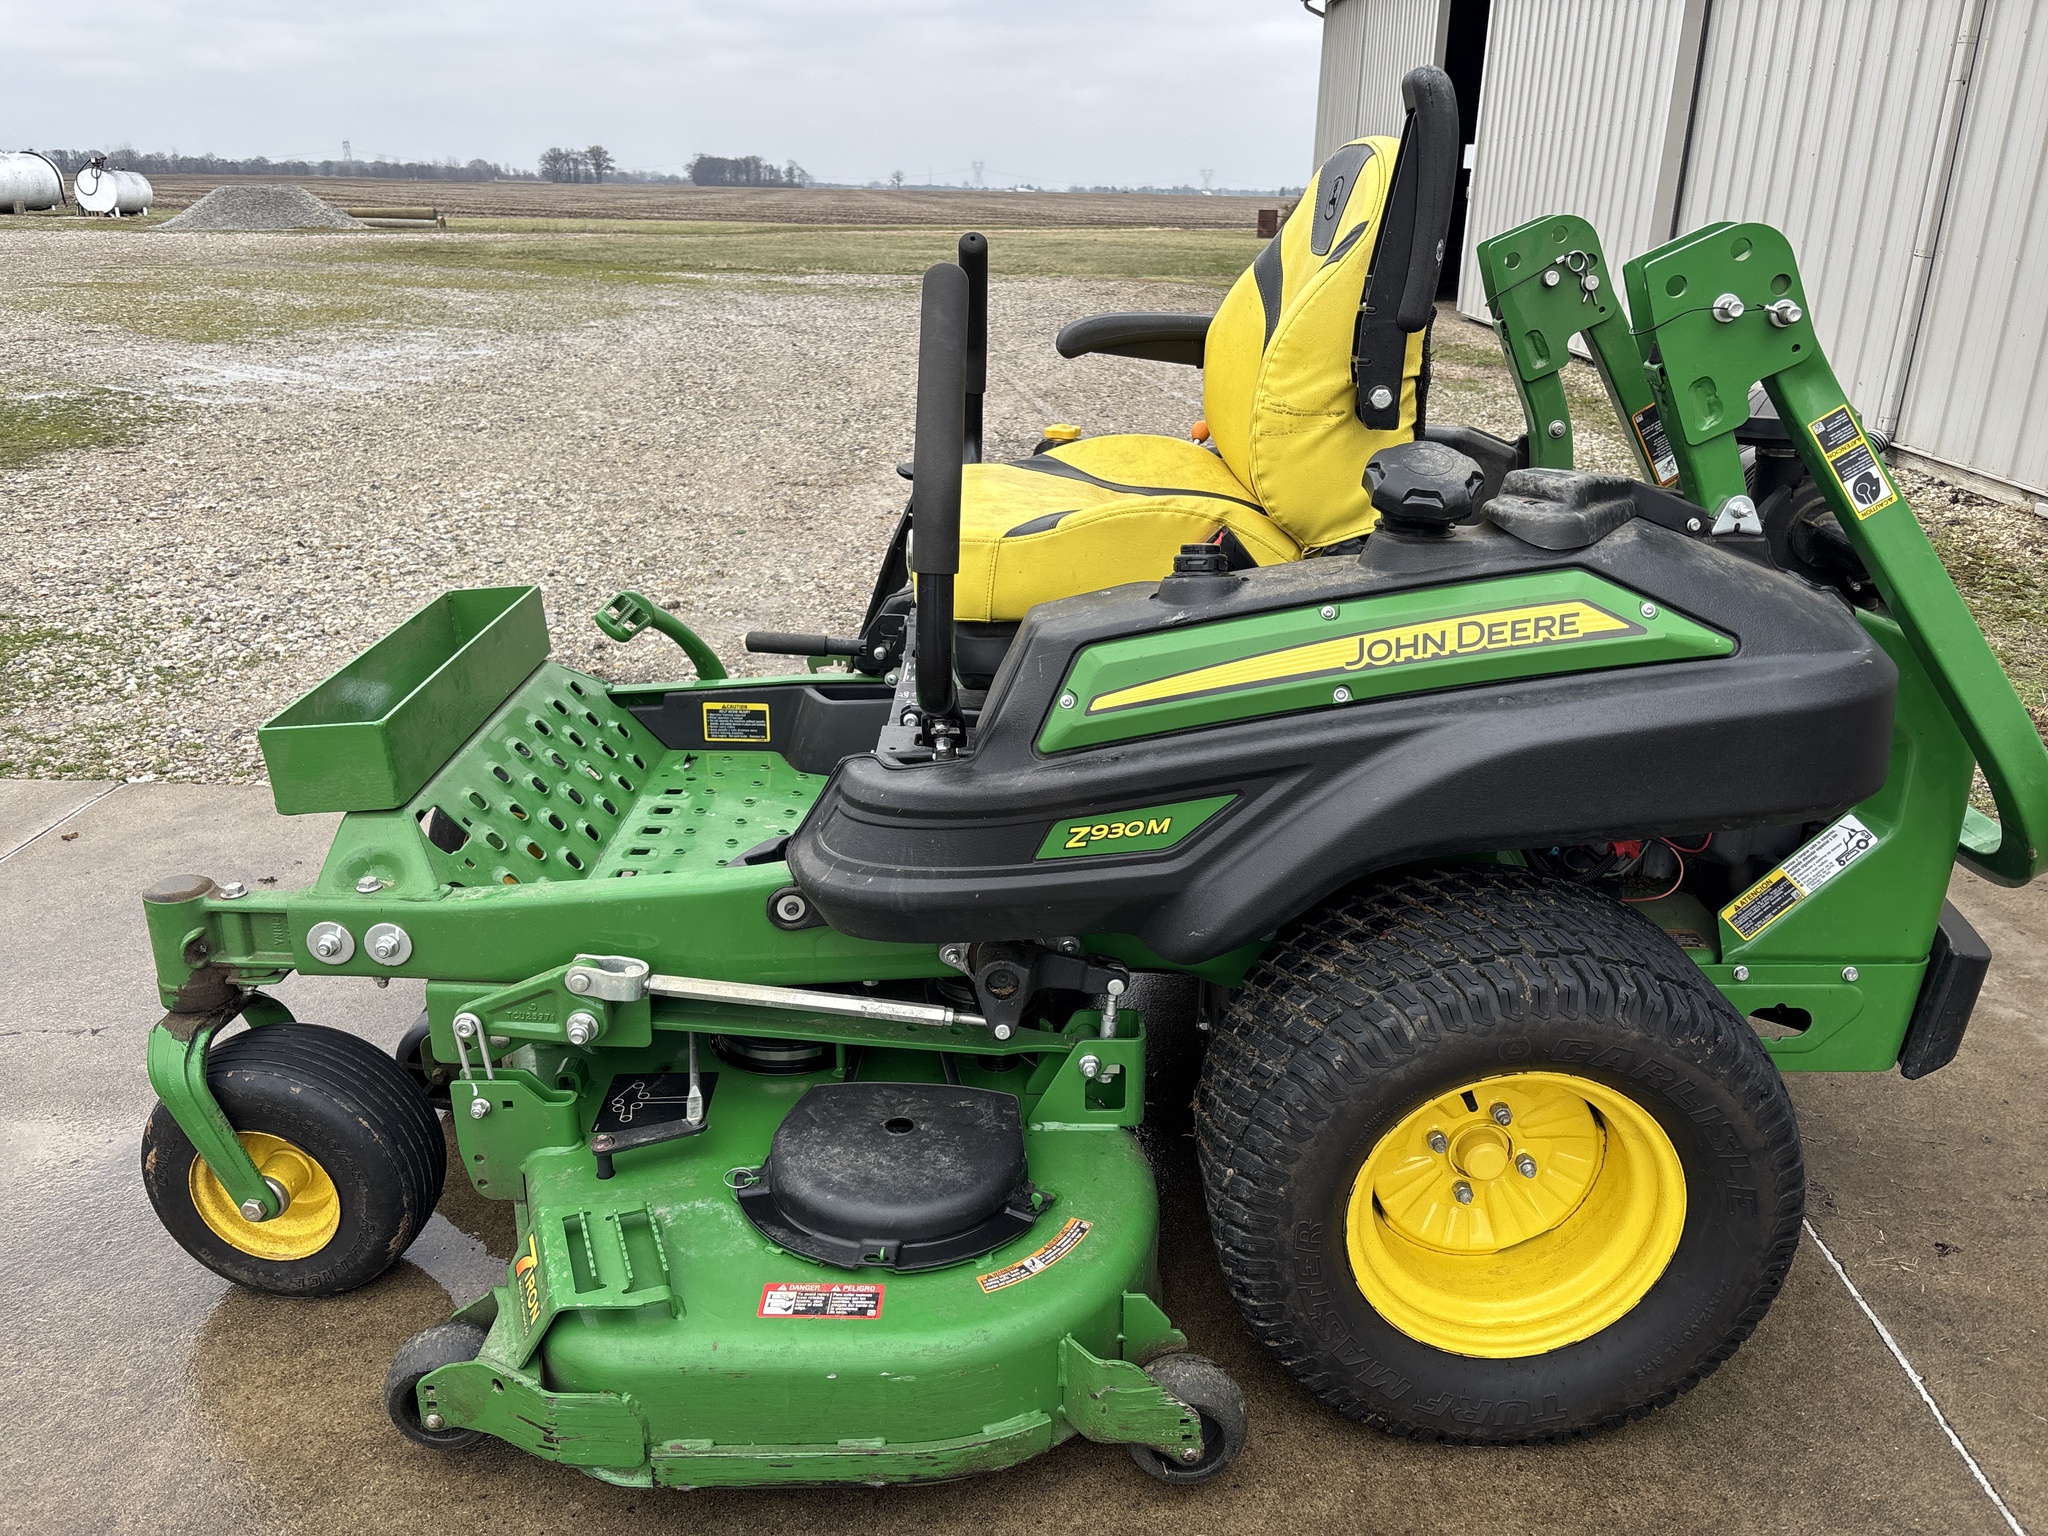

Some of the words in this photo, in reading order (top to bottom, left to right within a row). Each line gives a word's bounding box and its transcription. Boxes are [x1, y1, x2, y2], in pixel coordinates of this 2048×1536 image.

[1861, 498, 1889, 518] CAUTION
[1345, 630, 1446, 667] JOHN
[1457, 612, 1580, 650] DEERE
[1063, 816, 1173, 850] Z930M
[1740, 879, 1773, 906] ATENCION
[1549, 1038, 1758, 1217] CARLISLE
[291, 1218, 375, 1289] RELIANCE
[1294, 1220, 1413, 1400] MASTER
[1412, 1392, 1568, 1426] TURF
